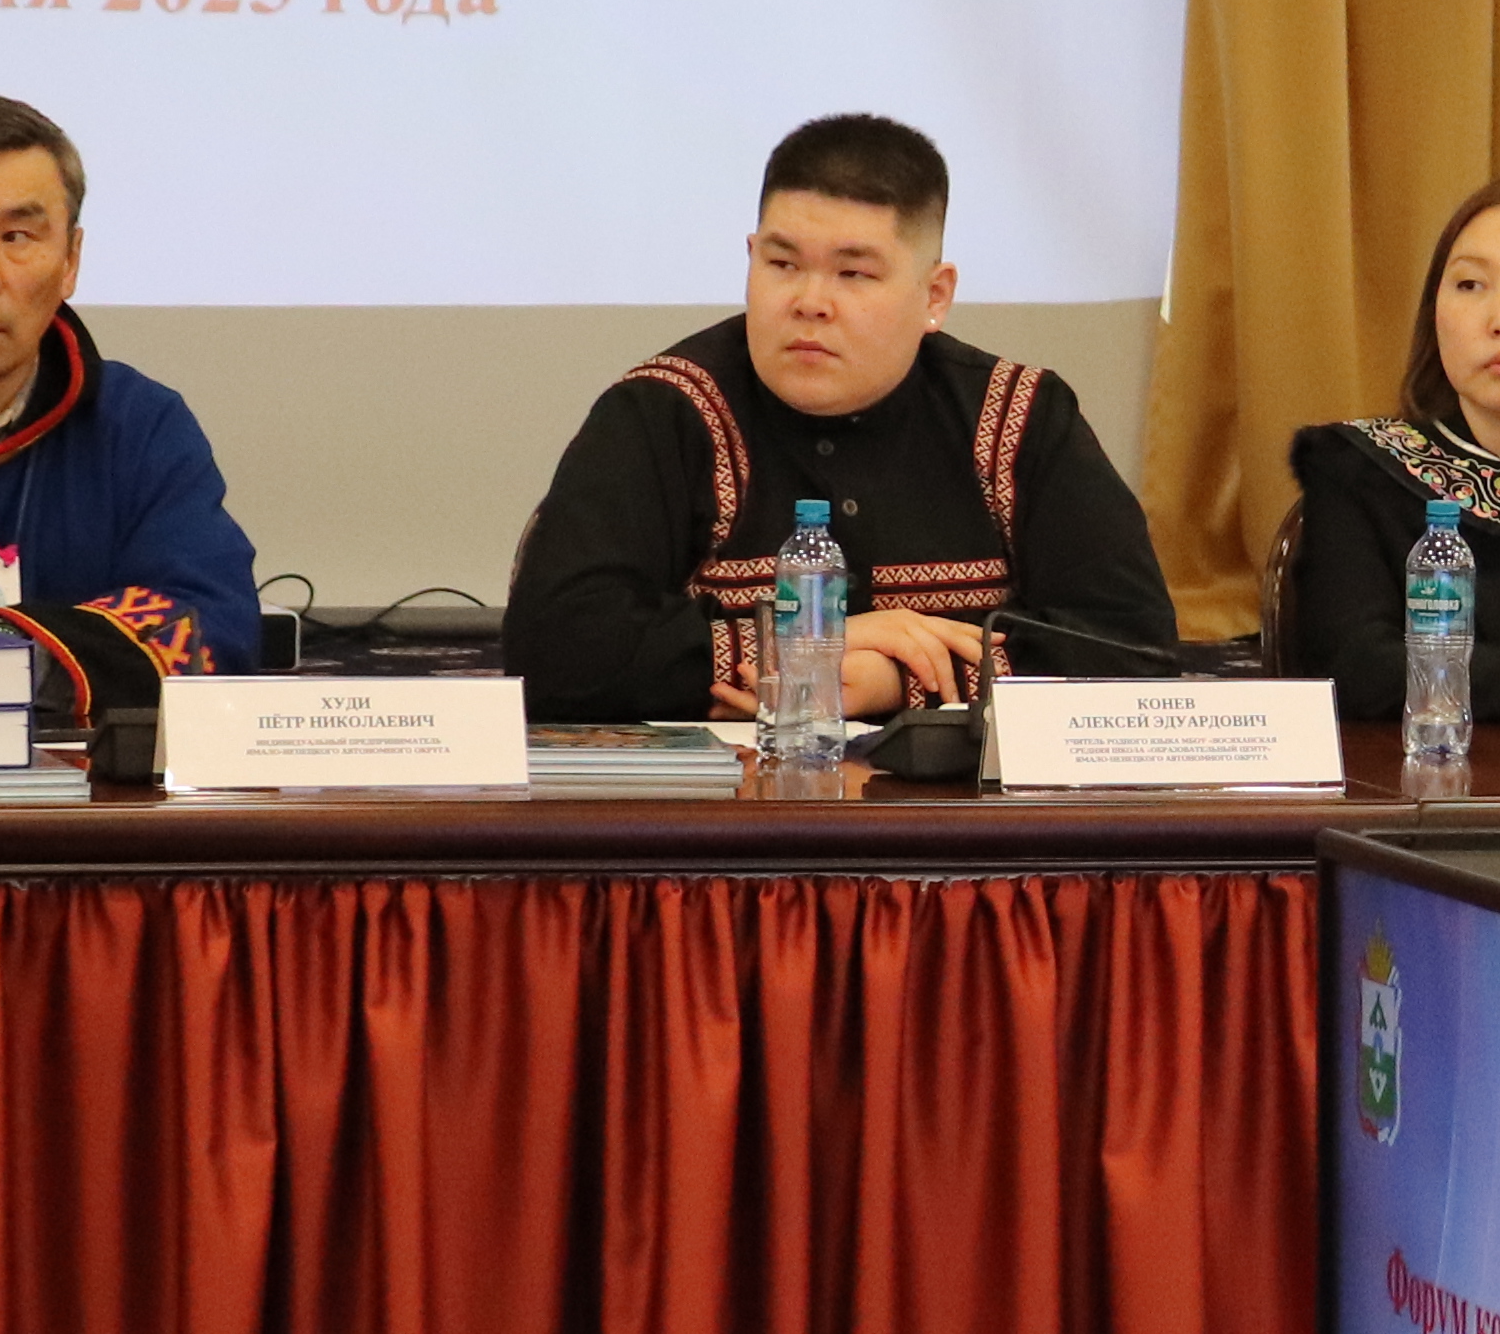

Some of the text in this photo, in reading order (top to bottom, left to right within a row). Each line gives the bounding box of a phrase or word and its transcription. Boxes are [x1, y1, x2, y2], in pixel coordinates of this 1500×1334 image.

[320, 696, 371, 711] ХУДИ
[1137, 697, 1196, 711] КОНЕВ
[257, 713, 436, 730] ПЁТР НИКОЛАЕВИЧ
[1068, 714, 1268, 731] АЛЕКСЕЙ ЭДУАРДОВИЧ
